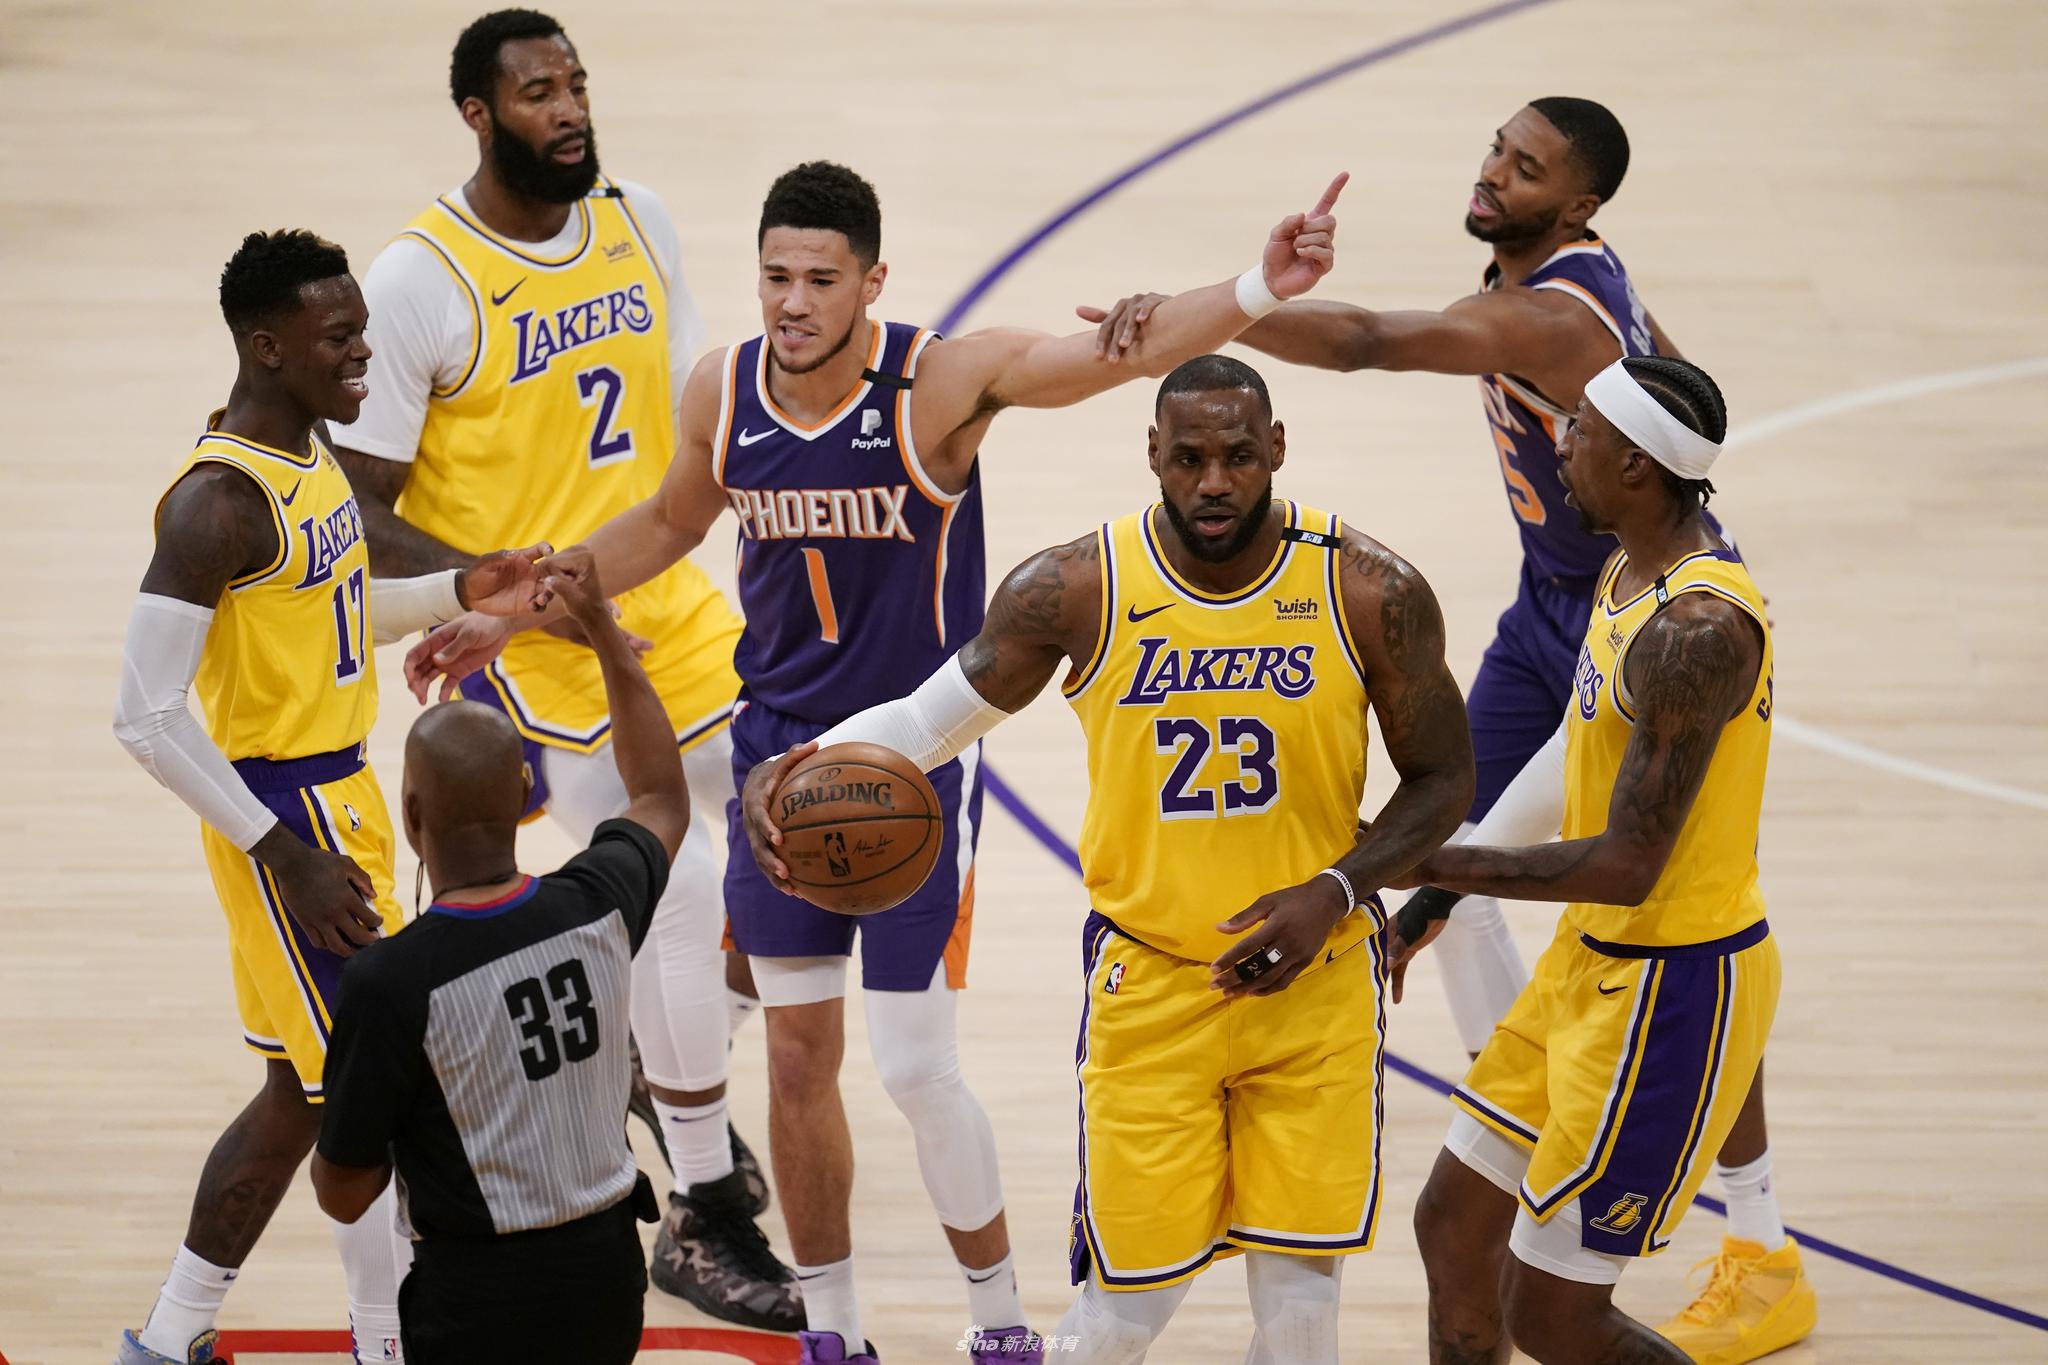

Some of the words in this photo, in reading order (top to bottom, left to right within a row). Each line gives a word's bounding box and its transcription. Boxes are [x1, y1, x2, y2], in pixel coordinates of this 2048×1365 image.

[508, 283, 653, 385] LAKERS
[575, 366, 635, 469] 2
[851, 437, 891, 450] PayPal
[725, 484, 916, 543] PHOENIX
[332, 566, 366, 688] 17
[800, 547, 839, 645] 1
[1274, 598, 1318, 613] wish
[1117, 638, 1316, 706] LAKERS
[781, 783, 893, 823] SPALDING
[1155, 716, 1280, 821] 23
[504, 958, 600, 1081] 33
